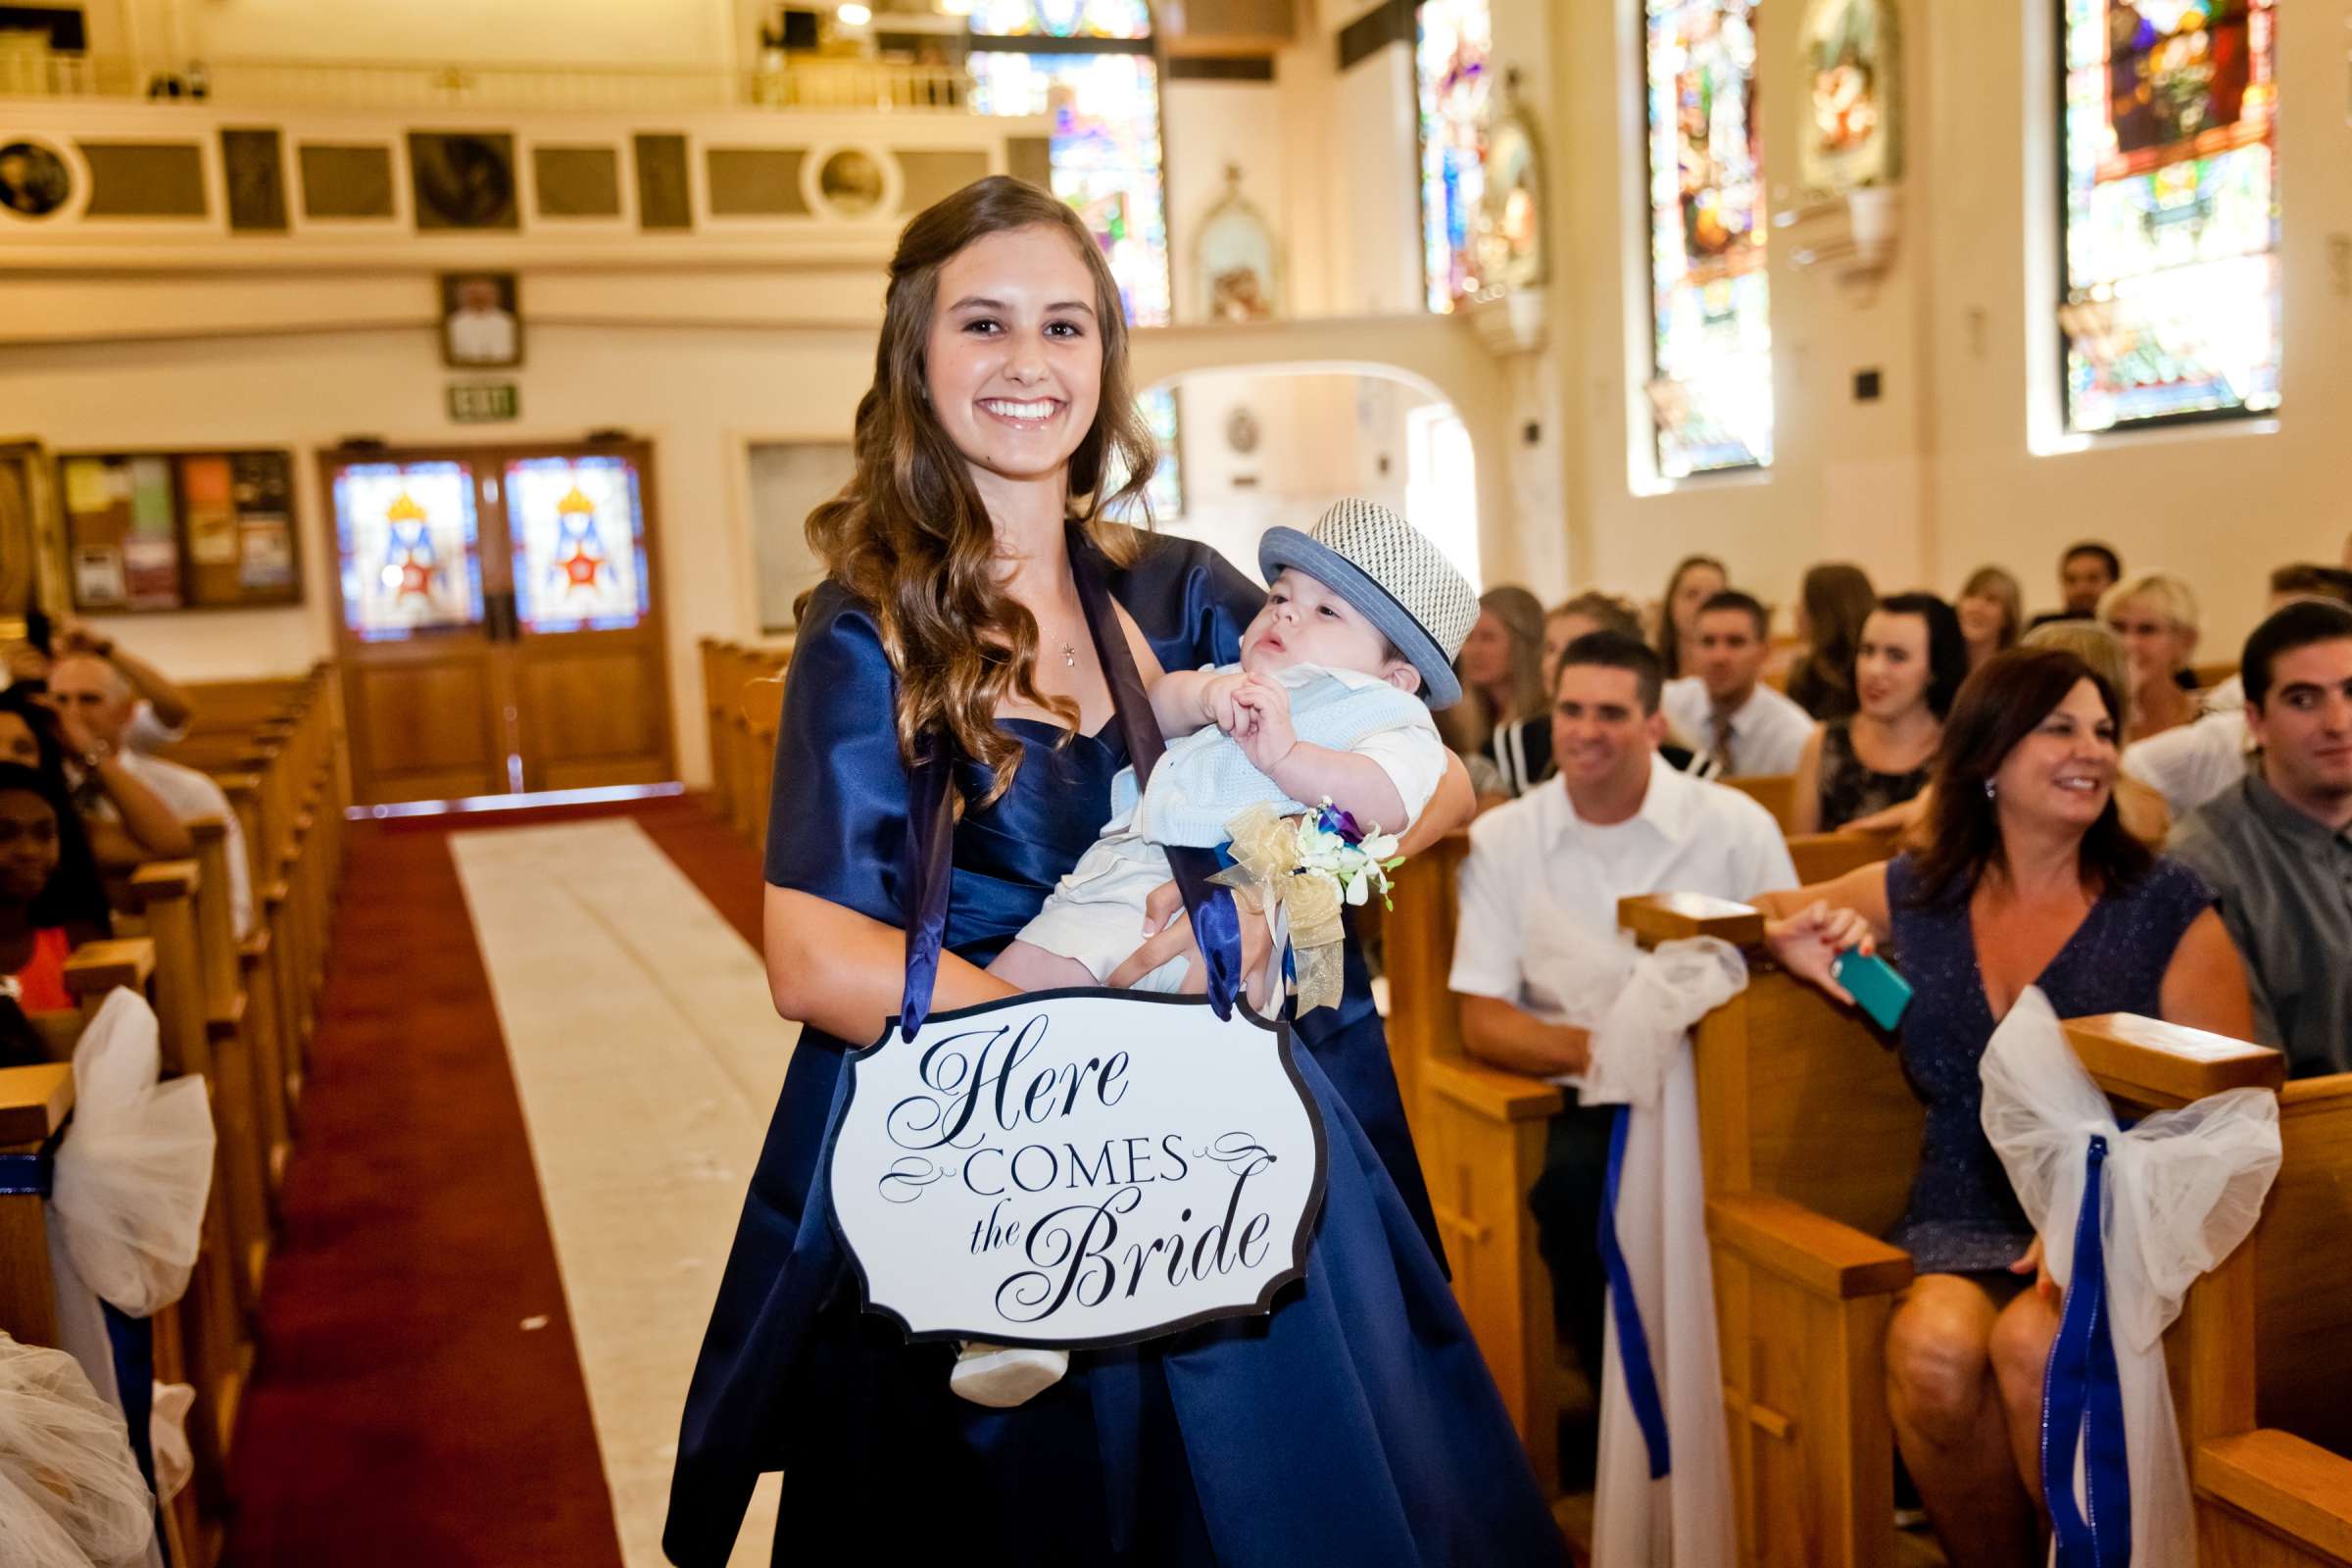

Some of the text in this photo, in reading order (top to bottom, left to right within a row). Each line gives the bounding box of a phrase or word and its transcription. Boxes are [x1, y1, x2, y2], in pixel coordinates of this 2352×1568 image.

[886, 1013, 1130, 1151] Here
[962, 1134, 1189, 1196] COMES
[969, 1154, 1278, 1323] the Bride
